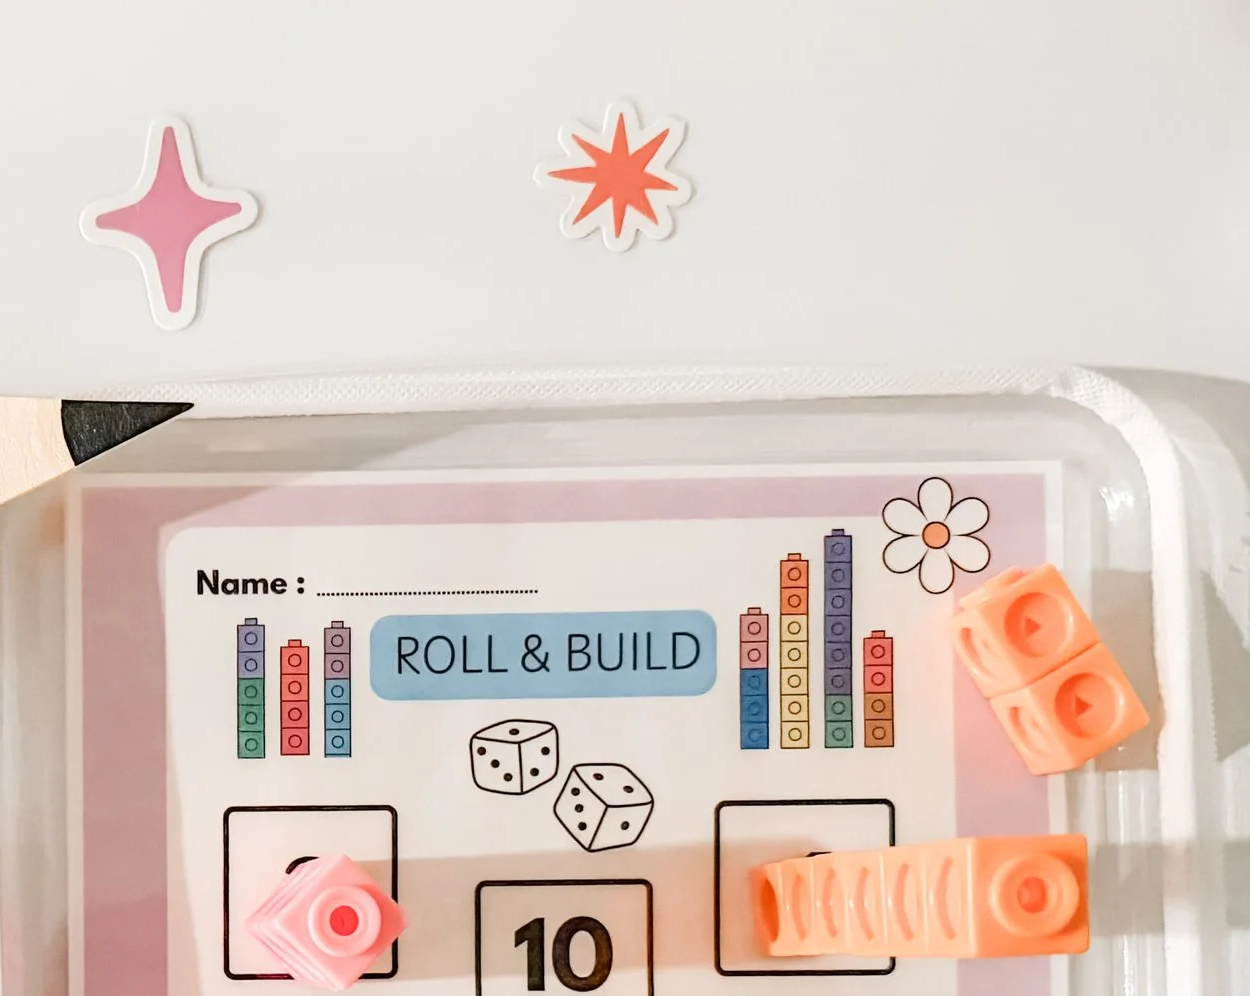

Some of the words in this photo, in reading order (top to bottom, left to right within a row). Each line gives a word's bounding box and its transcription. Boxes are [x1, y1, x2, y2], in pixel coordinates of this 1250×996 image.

[196, 569, 288, 596] Name
[397, 634, 509, 675] ROLL
[520, 633, 551, 673] &
[567, 631, 701, 672] BUILD
[514, 915, 614, 993] 10
